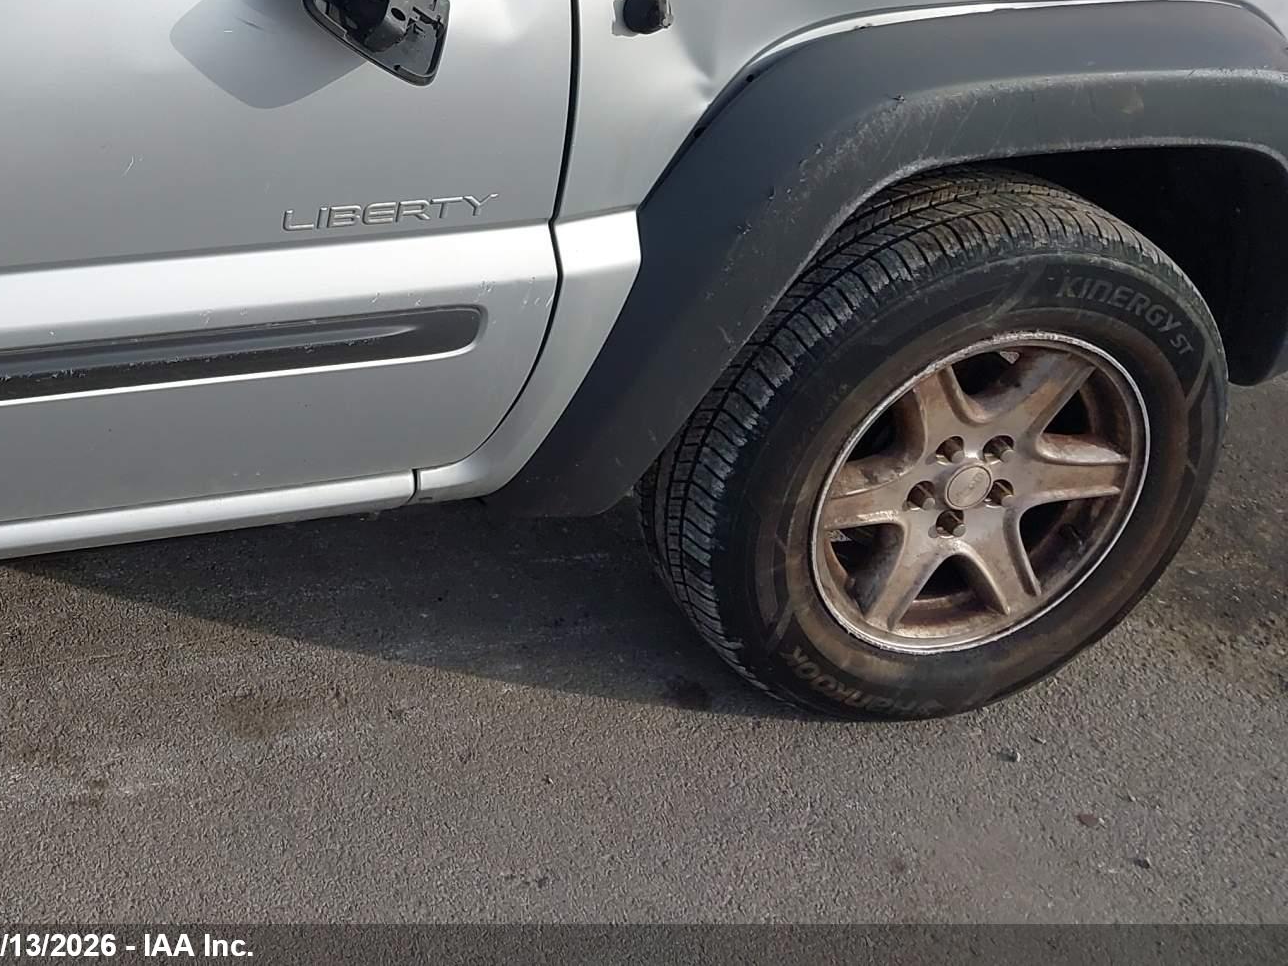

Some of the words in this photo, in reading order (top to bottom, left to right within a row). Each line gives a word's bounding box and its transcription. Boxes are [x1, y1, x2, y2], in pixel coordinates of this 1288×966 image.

[283, 193, 499, 231] LIBERTY
[1056, 276, 1182, 332] KINERGY
[1170, 334, 1194, 355] ST
